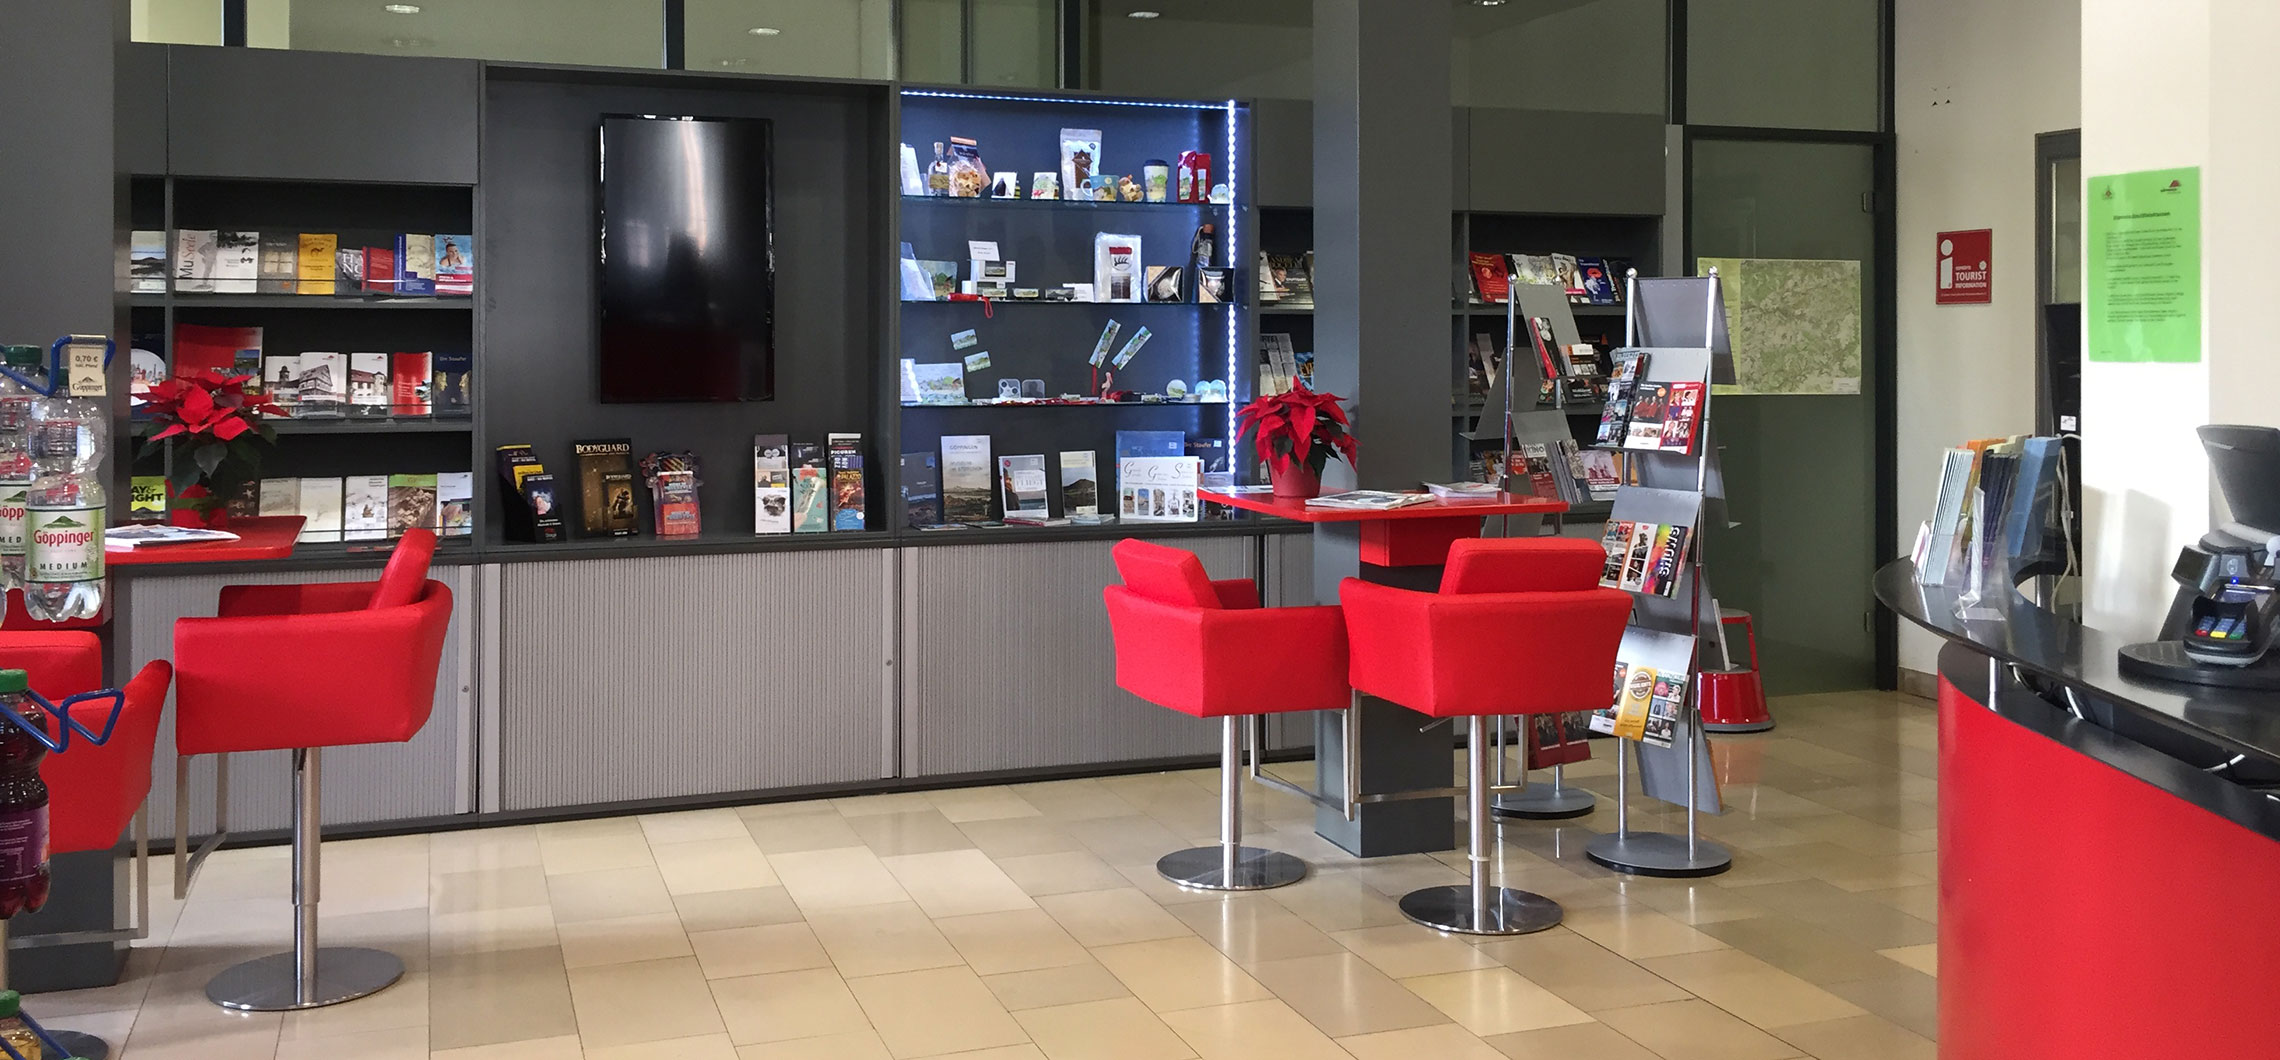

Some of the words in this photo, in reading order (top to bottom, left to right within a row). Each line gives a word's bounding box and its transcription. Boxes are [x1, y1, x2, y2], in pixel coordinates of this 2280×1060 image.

[1955, 271, 1987, 281] TOURIST
[575, 443, 630, 454] BODYGUARD
[131, 493, 164, 502] IGHT
[33, 529, 95, 547] Göppinger
[39, 562, 88, 570] MEDIUM
